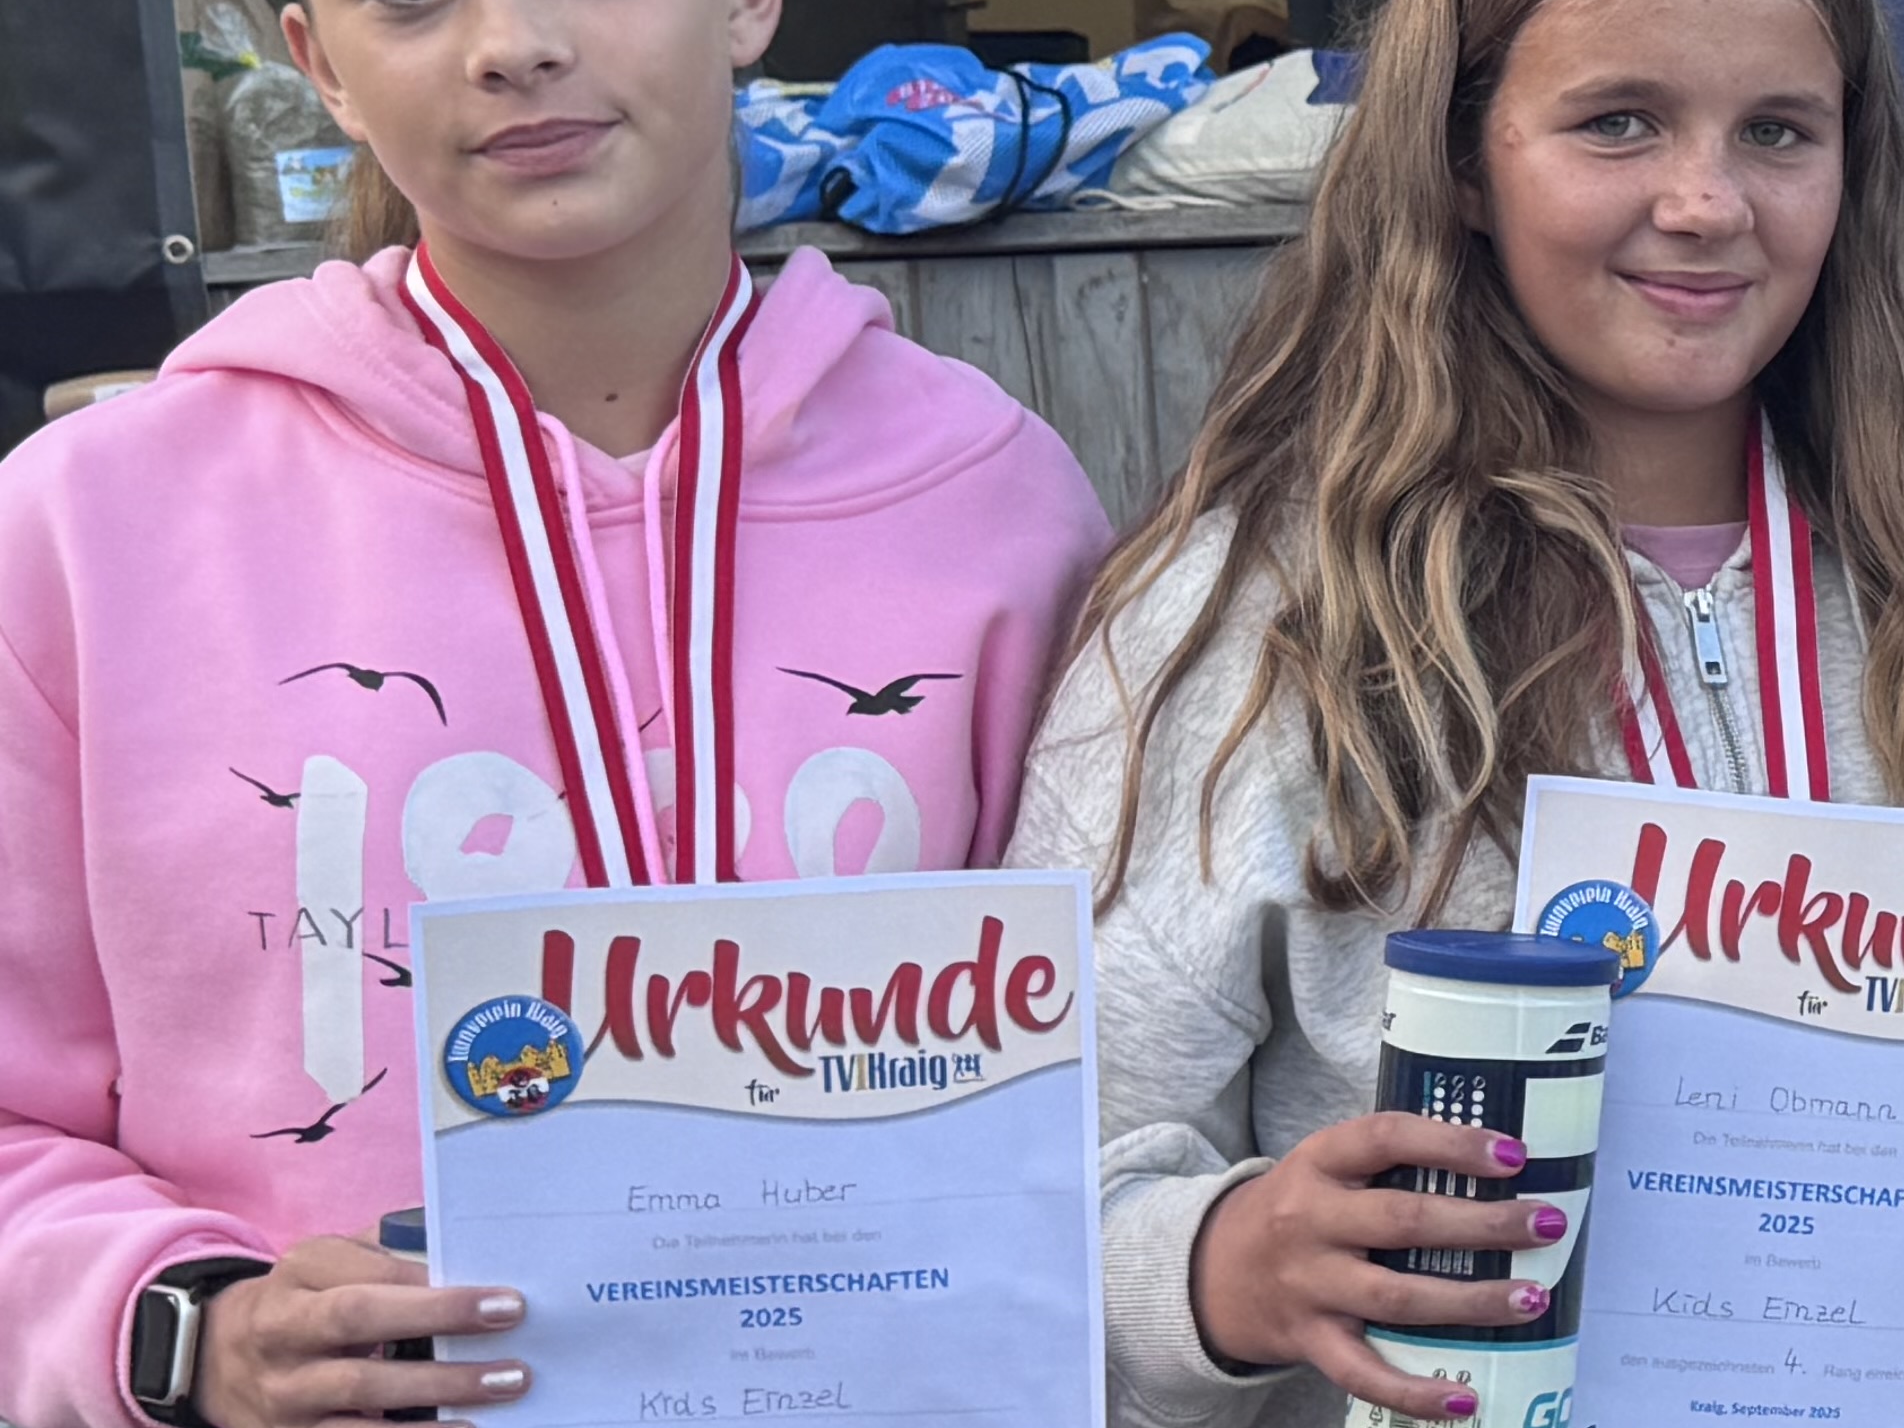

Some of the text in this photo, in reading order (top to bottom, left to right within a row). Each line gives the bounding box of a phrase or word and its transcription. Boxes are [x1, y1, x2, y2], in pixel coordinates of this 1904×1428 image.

[541, 915, 1074, 1076] Urkunde
[1674, 1075, 1897, 1122] Leni Obmann
[627, 1180, 858, 1213] Emma Huber
[1758, 1212, 1815, 1235] 2025
[586, 1267, 949, 1303] VEREINSMEISTERSCHAFTEN
[738, 1306, 803, 1329] 2025
[1783, 1347, 1808, 1375] 4.
